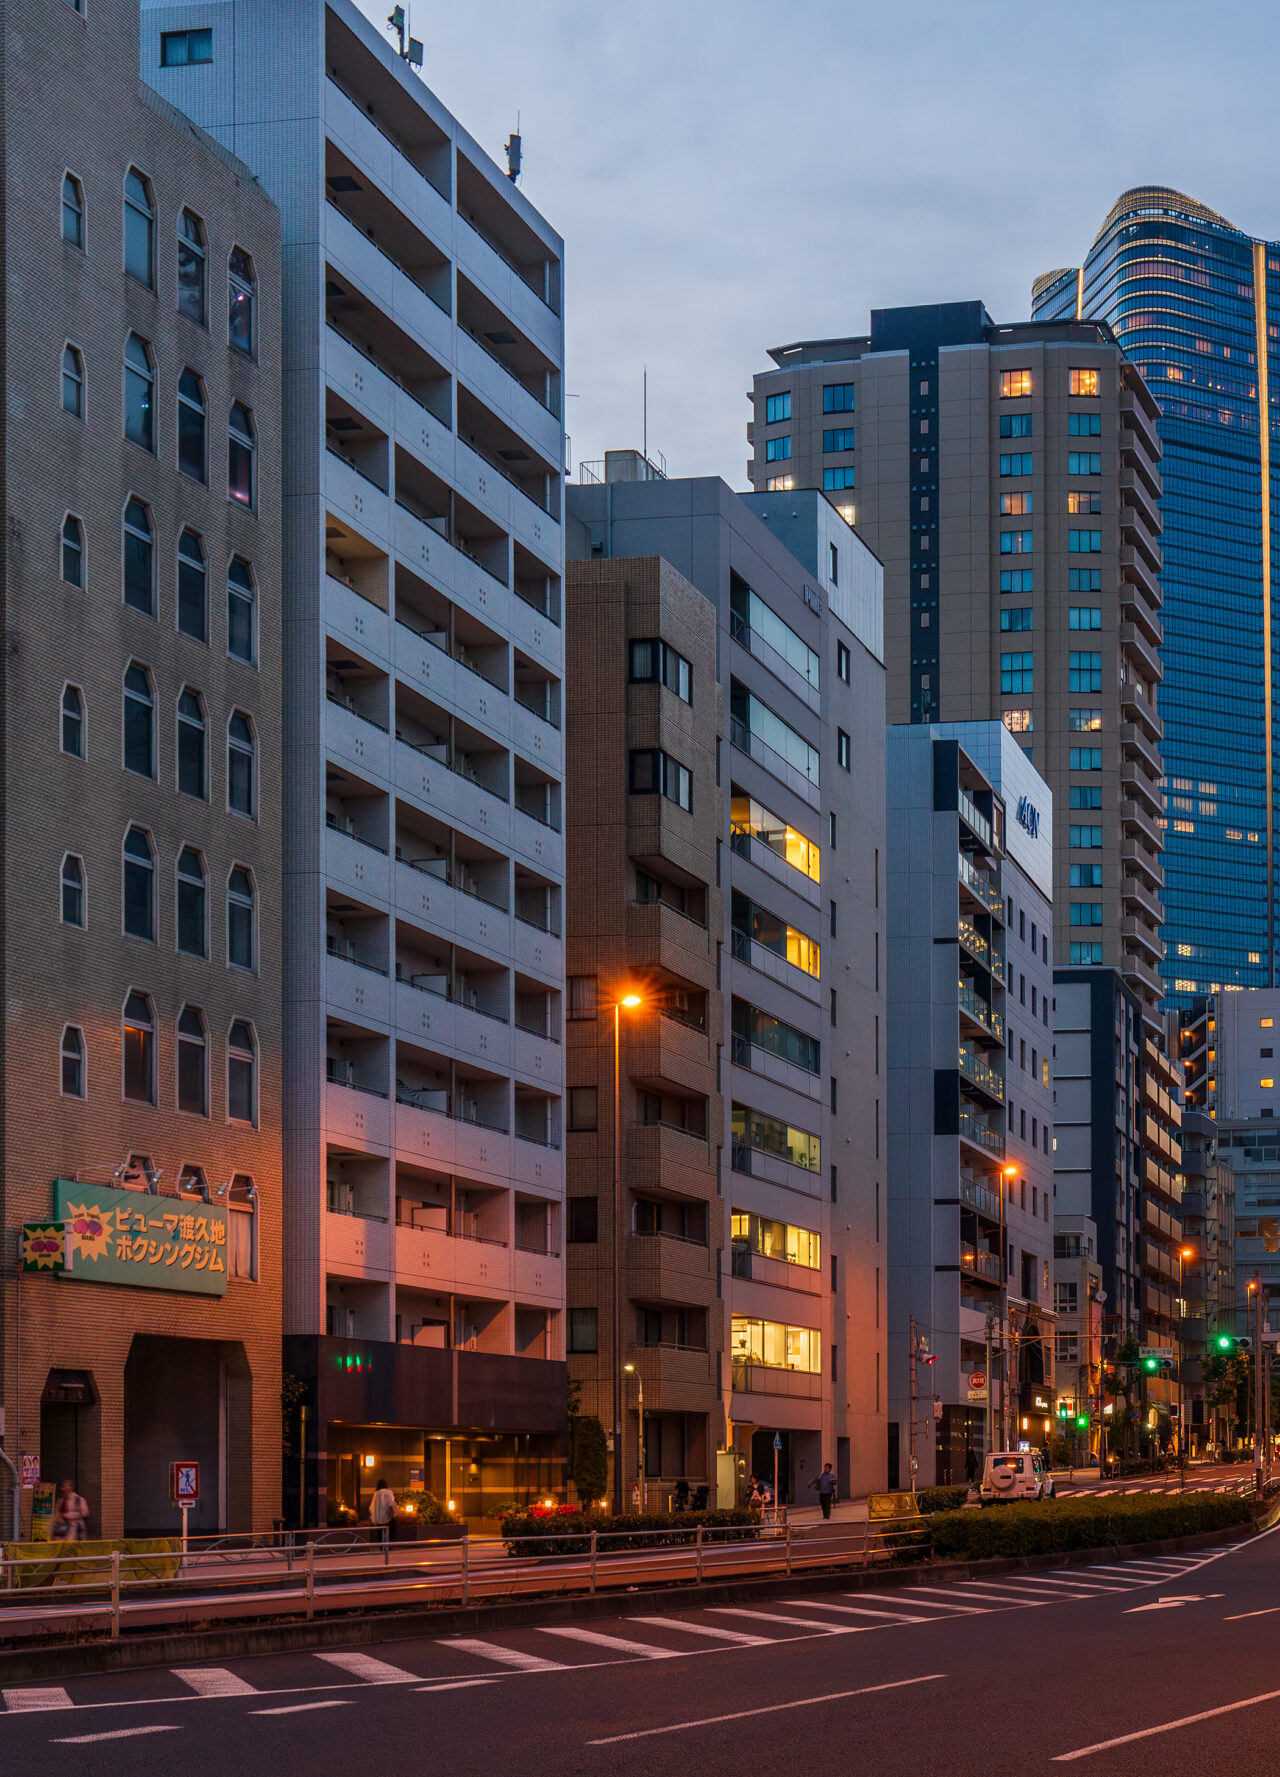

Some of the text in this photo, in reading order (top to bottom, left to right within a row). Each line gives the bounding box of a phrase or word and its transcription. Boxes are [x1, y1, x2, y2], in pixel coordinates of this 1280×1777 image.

[115, 1206, 226, 1246] ピューマ渡久地
[115, 1234, 225, 1273] ボクシングジム
